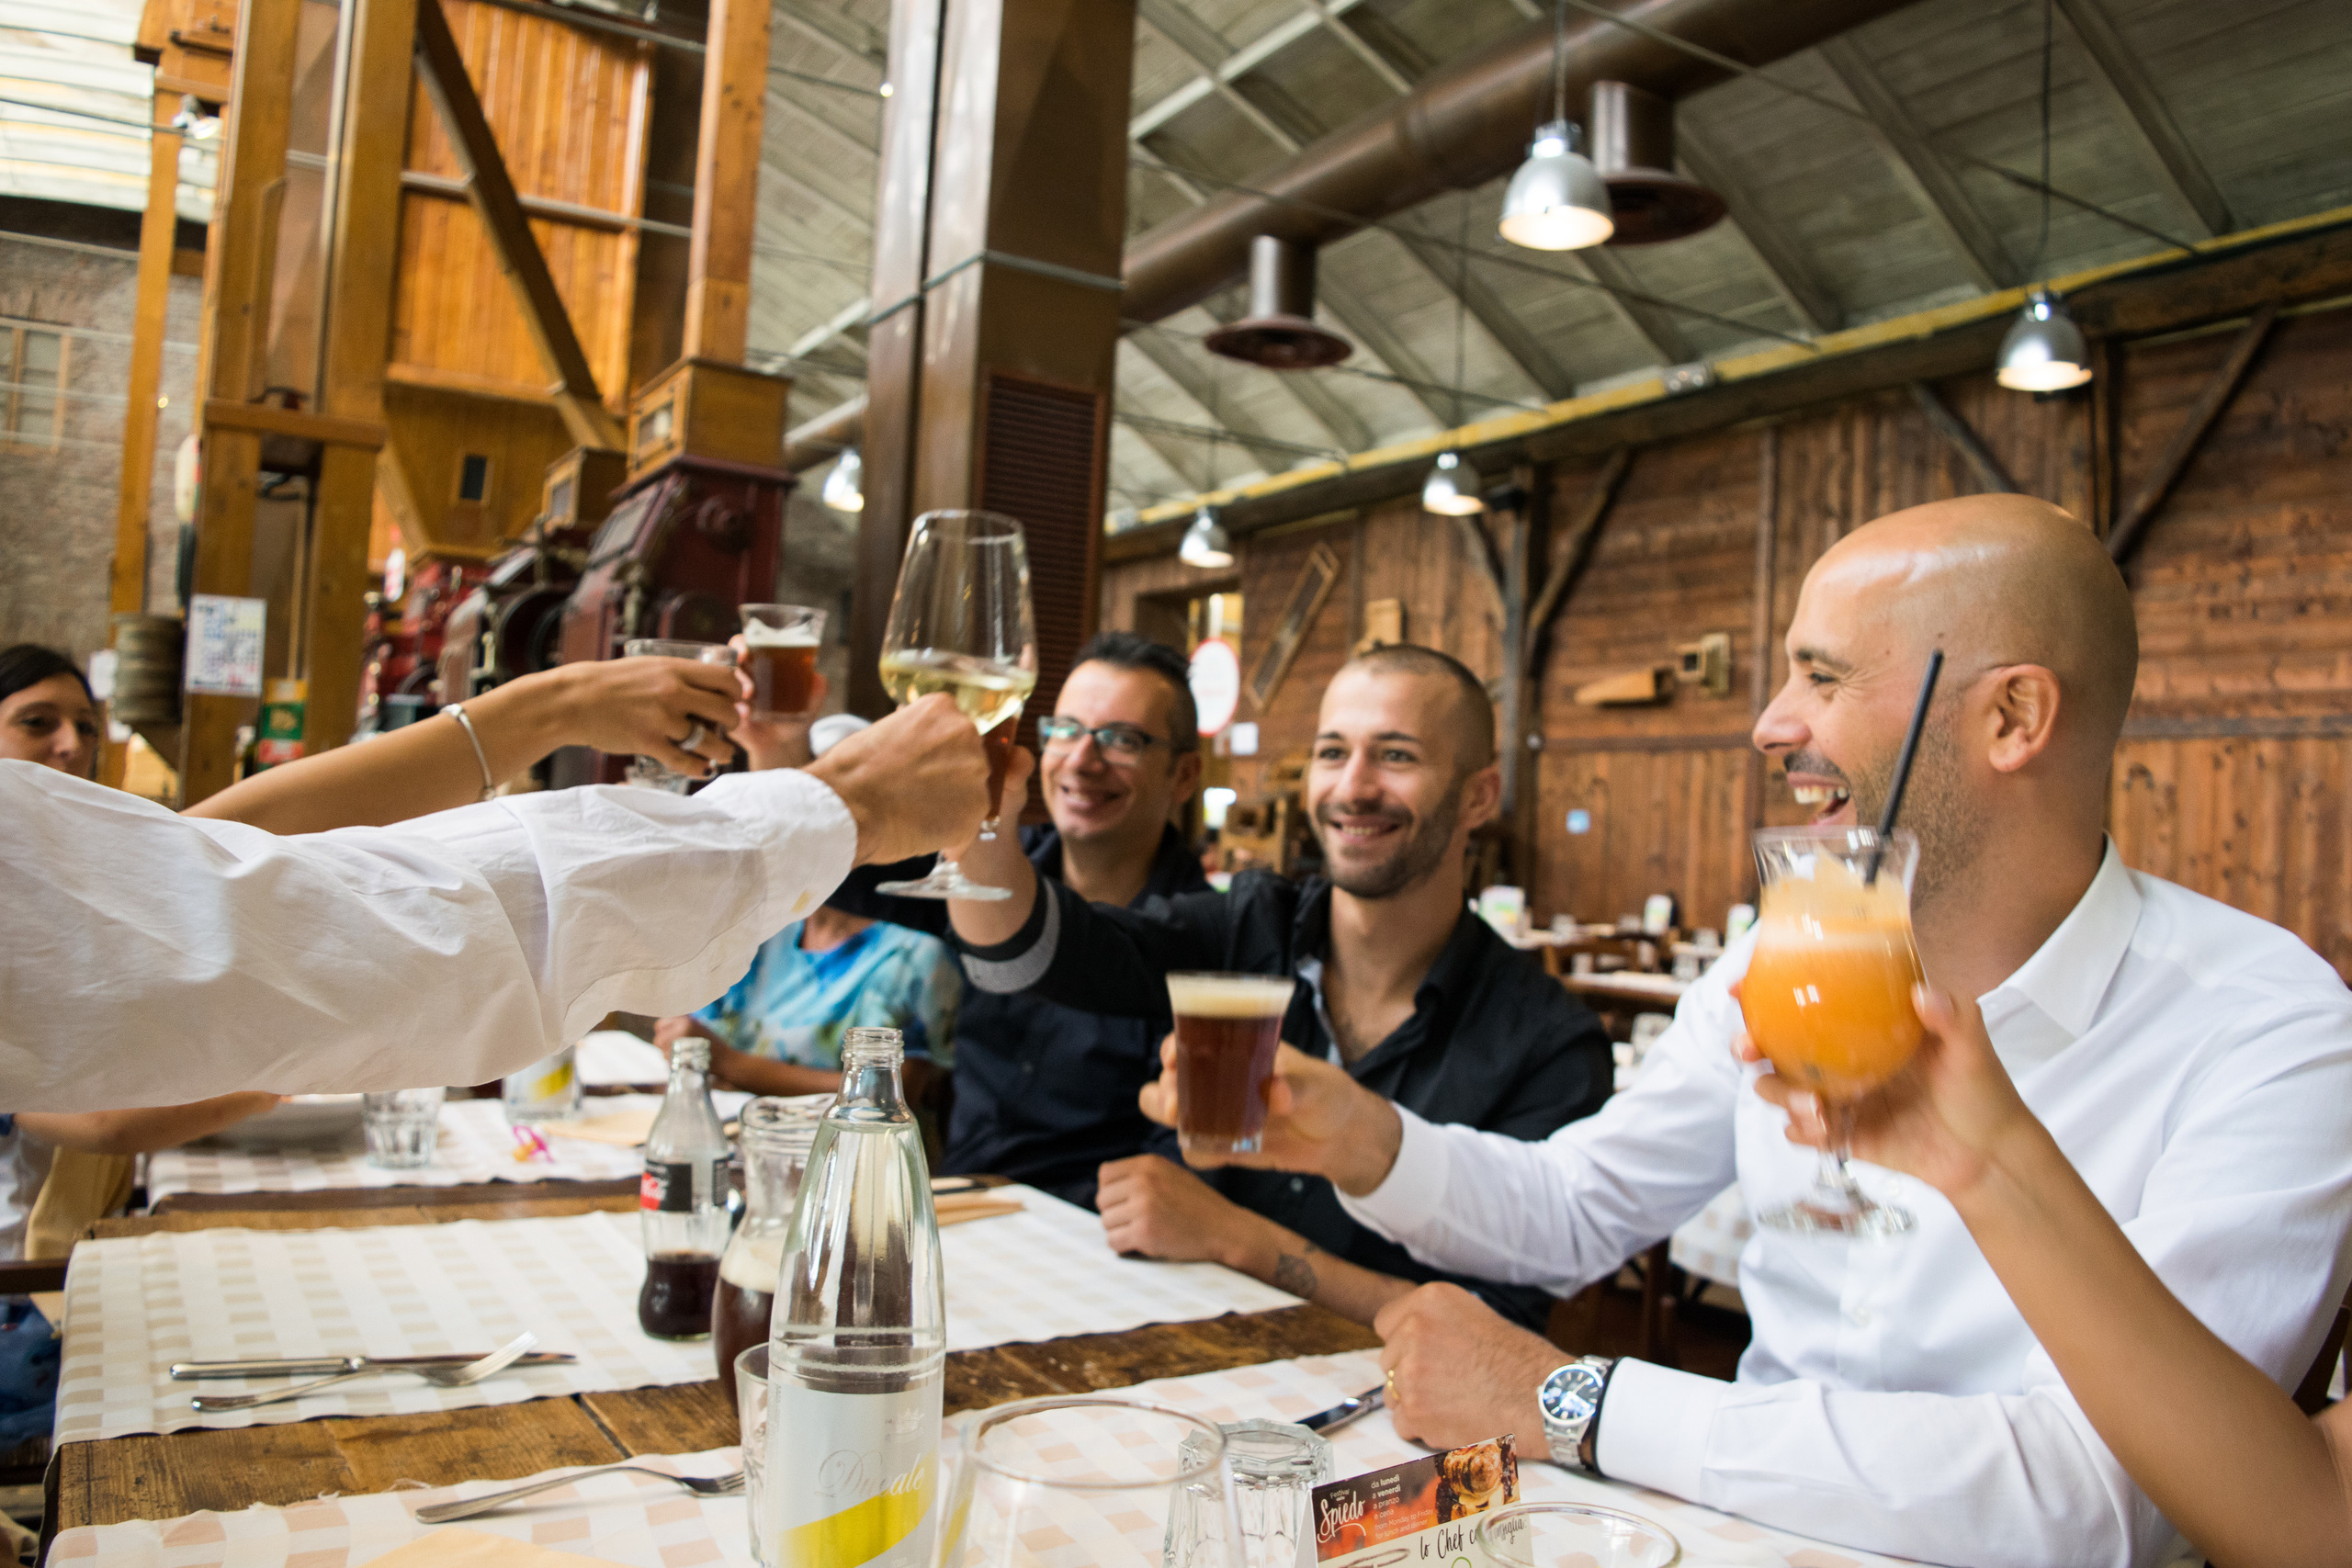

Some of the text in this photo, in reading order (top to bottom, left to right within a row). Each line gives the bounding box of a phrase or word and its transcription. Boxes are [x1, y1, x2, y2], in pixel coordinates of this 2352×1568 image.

[814, 1449, 925, 1499] Ducale
[1371, 1480, 1380, 1489] da
[1378, 1496, 1400, 1509] pranzo
[1317, 1490, 1366, 1543] Spiedo
[1379, 1508, 1395, 1518] cena
[1388, 1515, 1409, 1527] Monday
[1437, 1524, 1464, 1559] Chef
